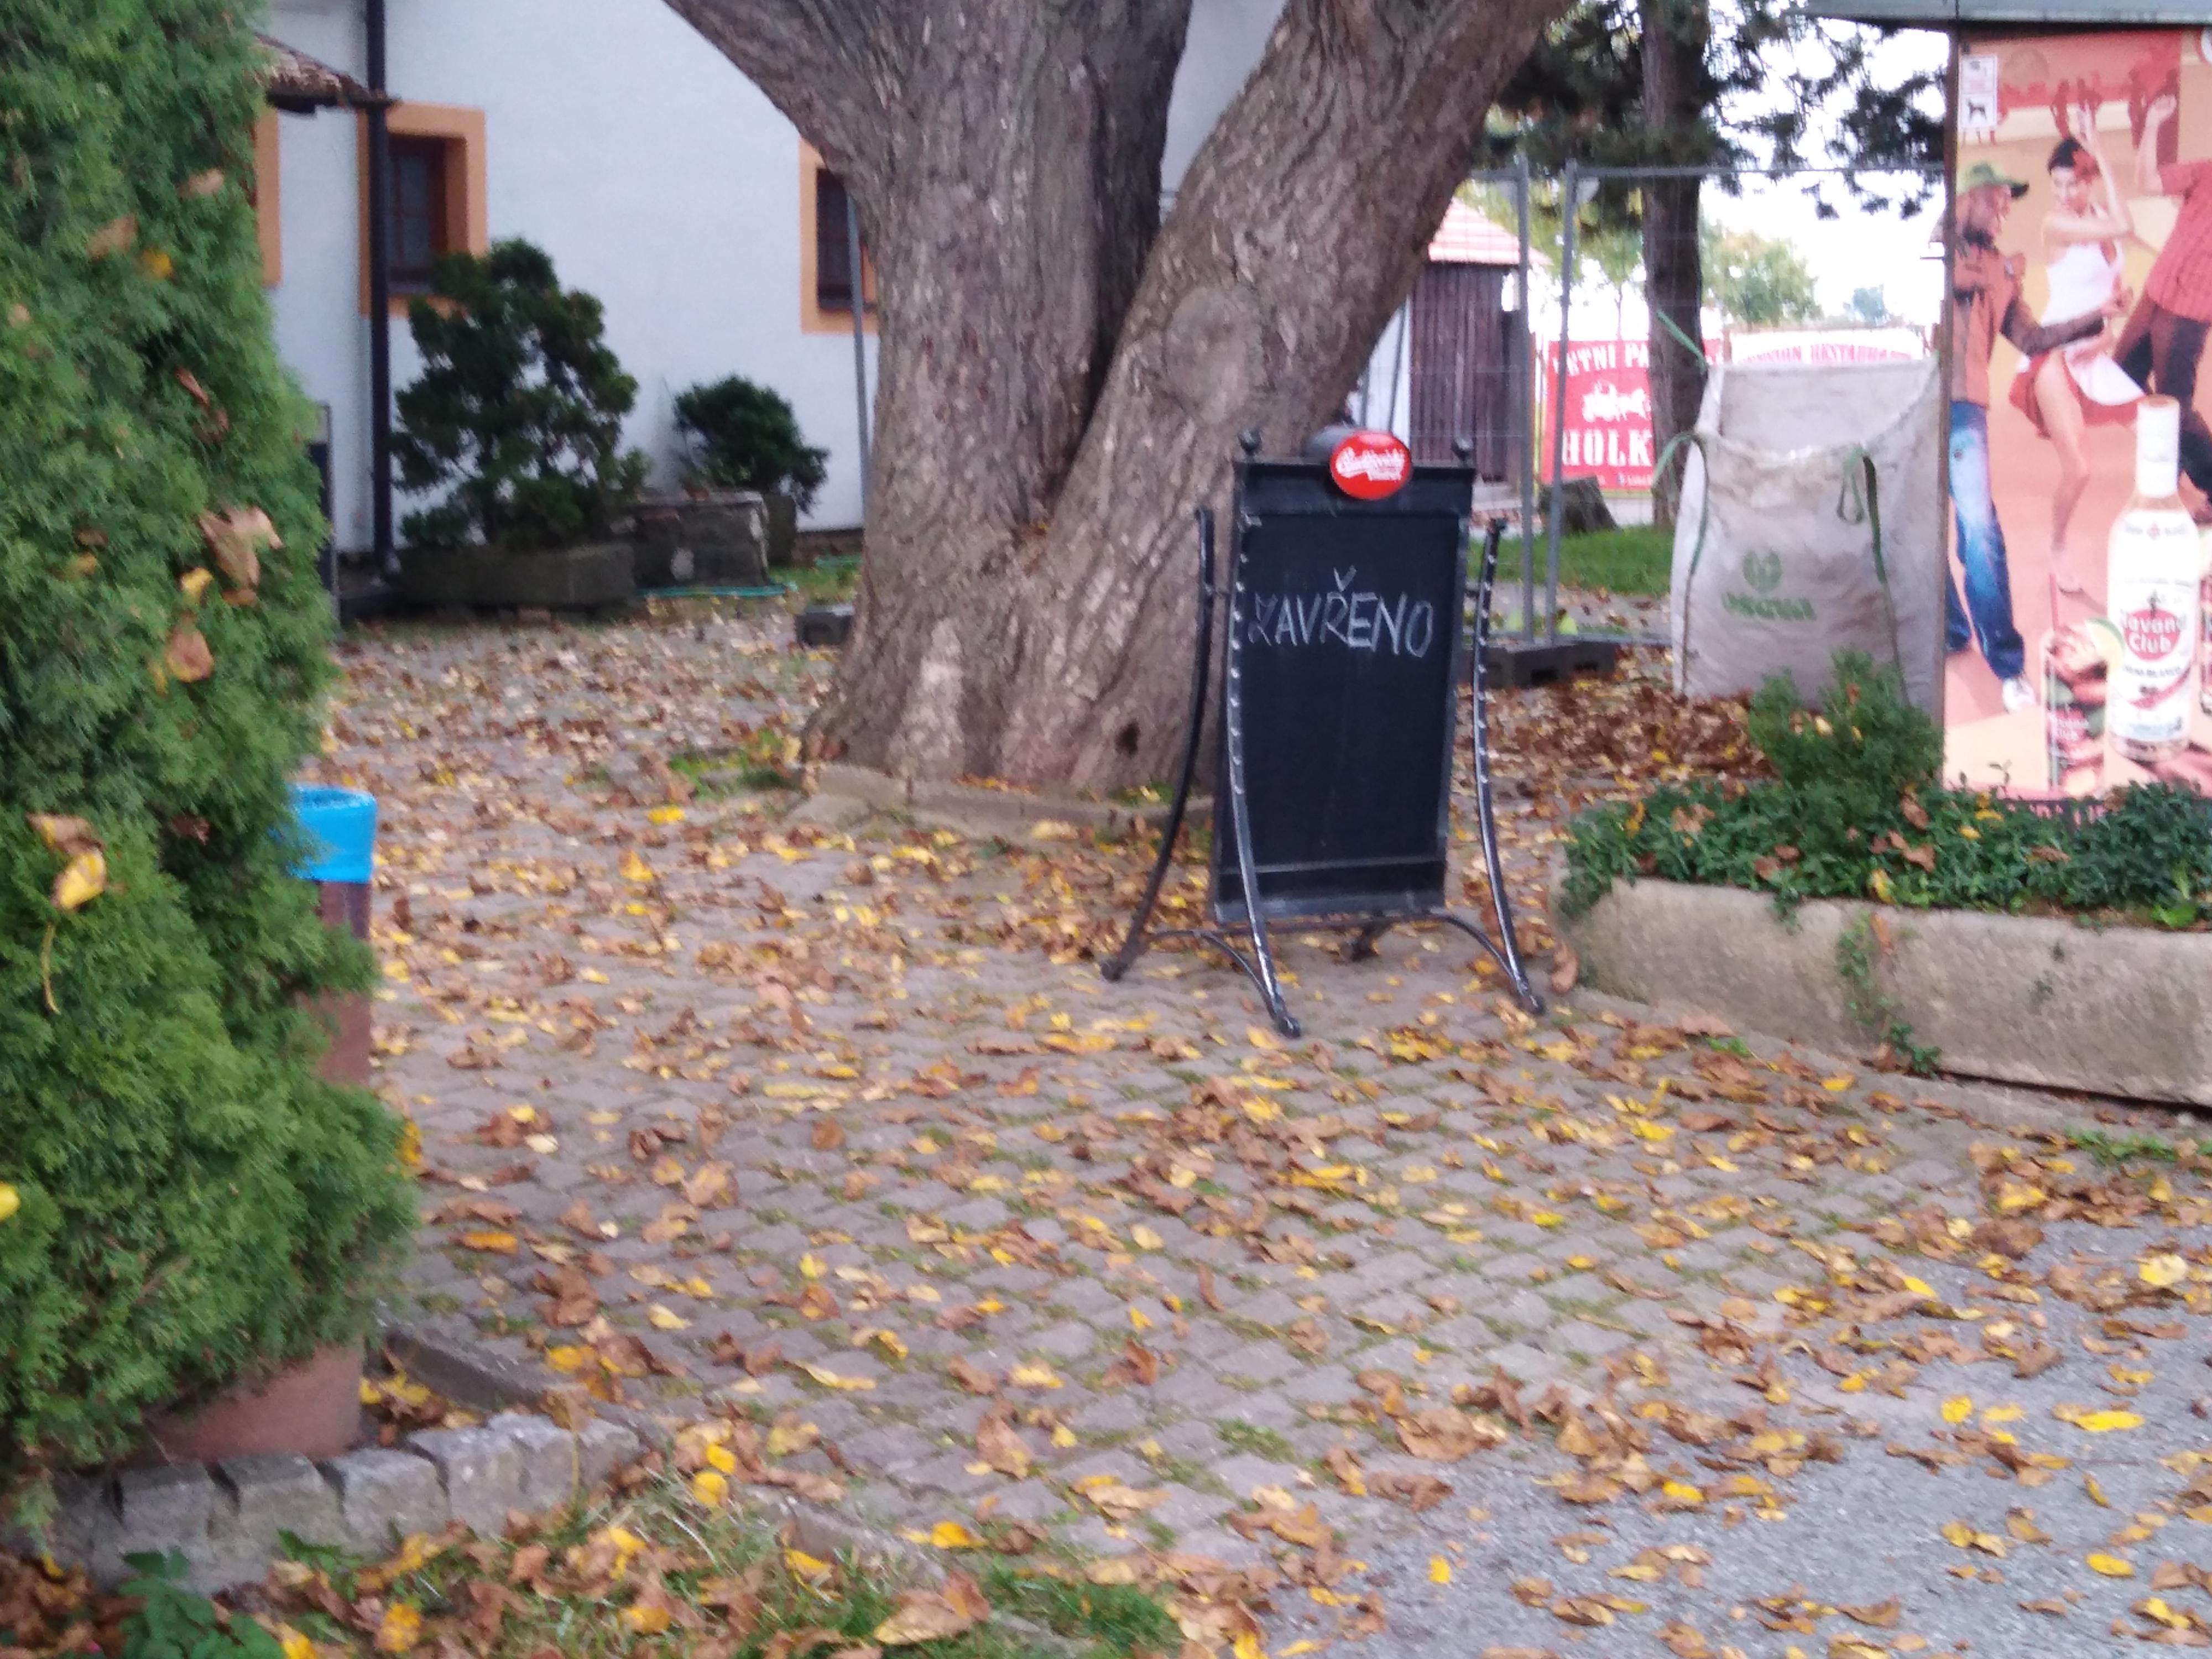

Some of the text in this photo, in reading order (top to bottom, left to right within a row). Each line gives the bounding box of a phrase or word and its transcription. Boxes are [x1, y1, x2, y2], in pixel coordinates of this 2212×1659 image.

[1561, 428, 1653, 467] HOLK
[1248, 565, 1433, 658] ZAVŘENO
[2128, 633, 2172, 654] Club
